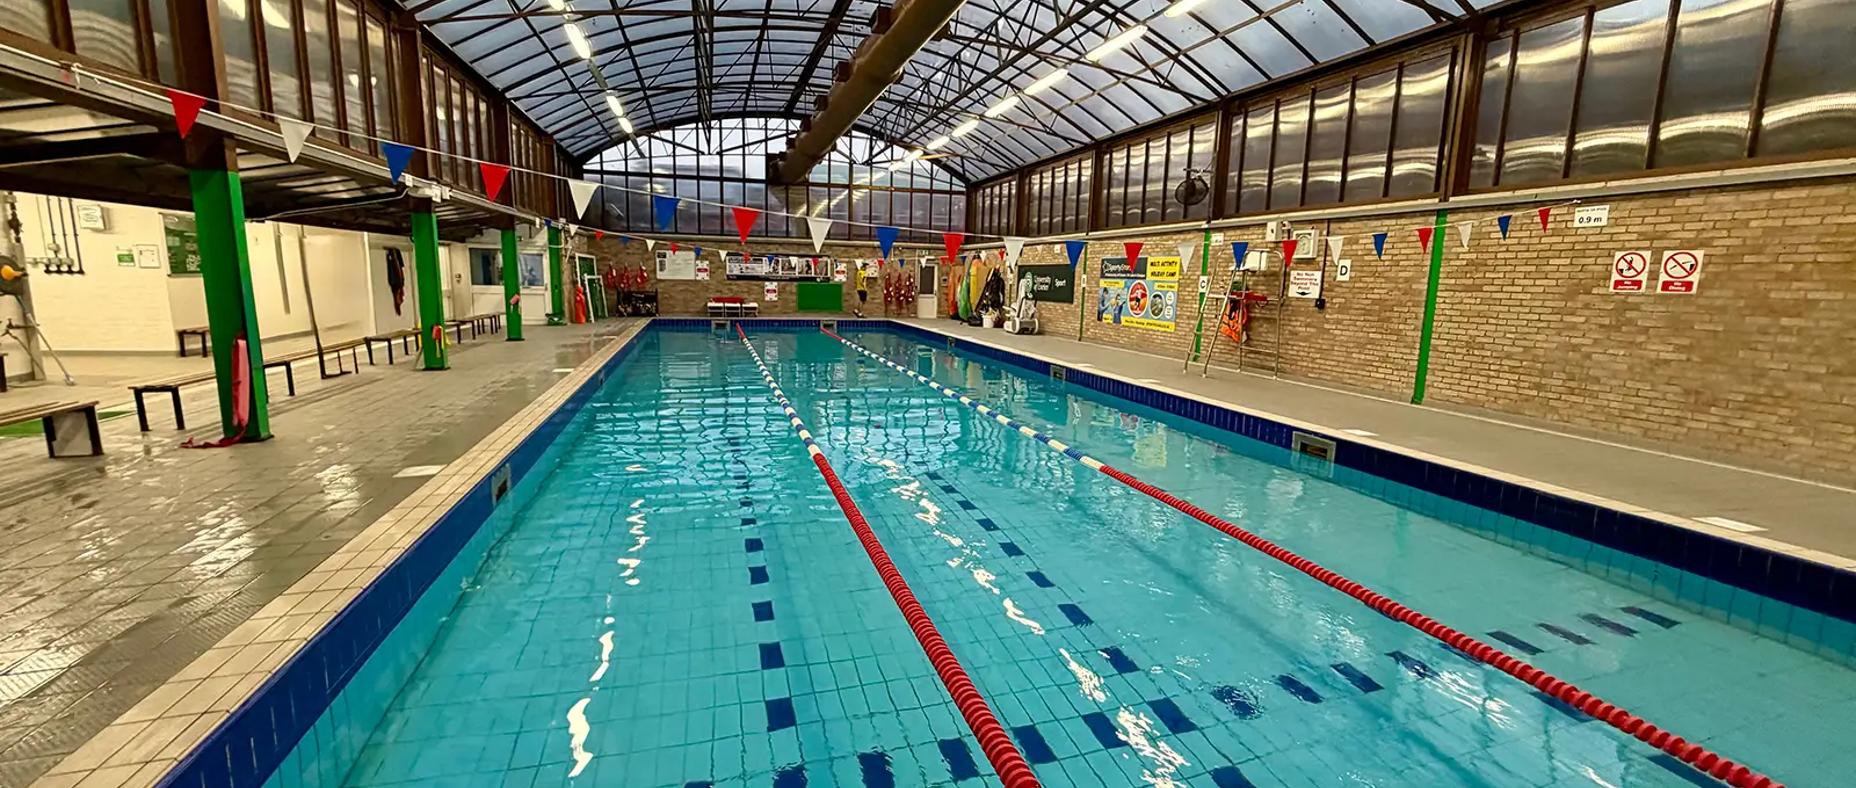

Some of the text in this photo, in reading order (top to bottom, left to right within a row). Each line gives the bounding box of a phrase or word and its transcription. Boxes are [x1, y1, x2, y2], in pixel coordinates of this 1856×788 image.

[1578, 216, 1592, 224] 0.9
[1340, 265, 1348, 276] D
[1055, 278, 1066, 288] Sport
[1200, 280, 1206, 289] C
